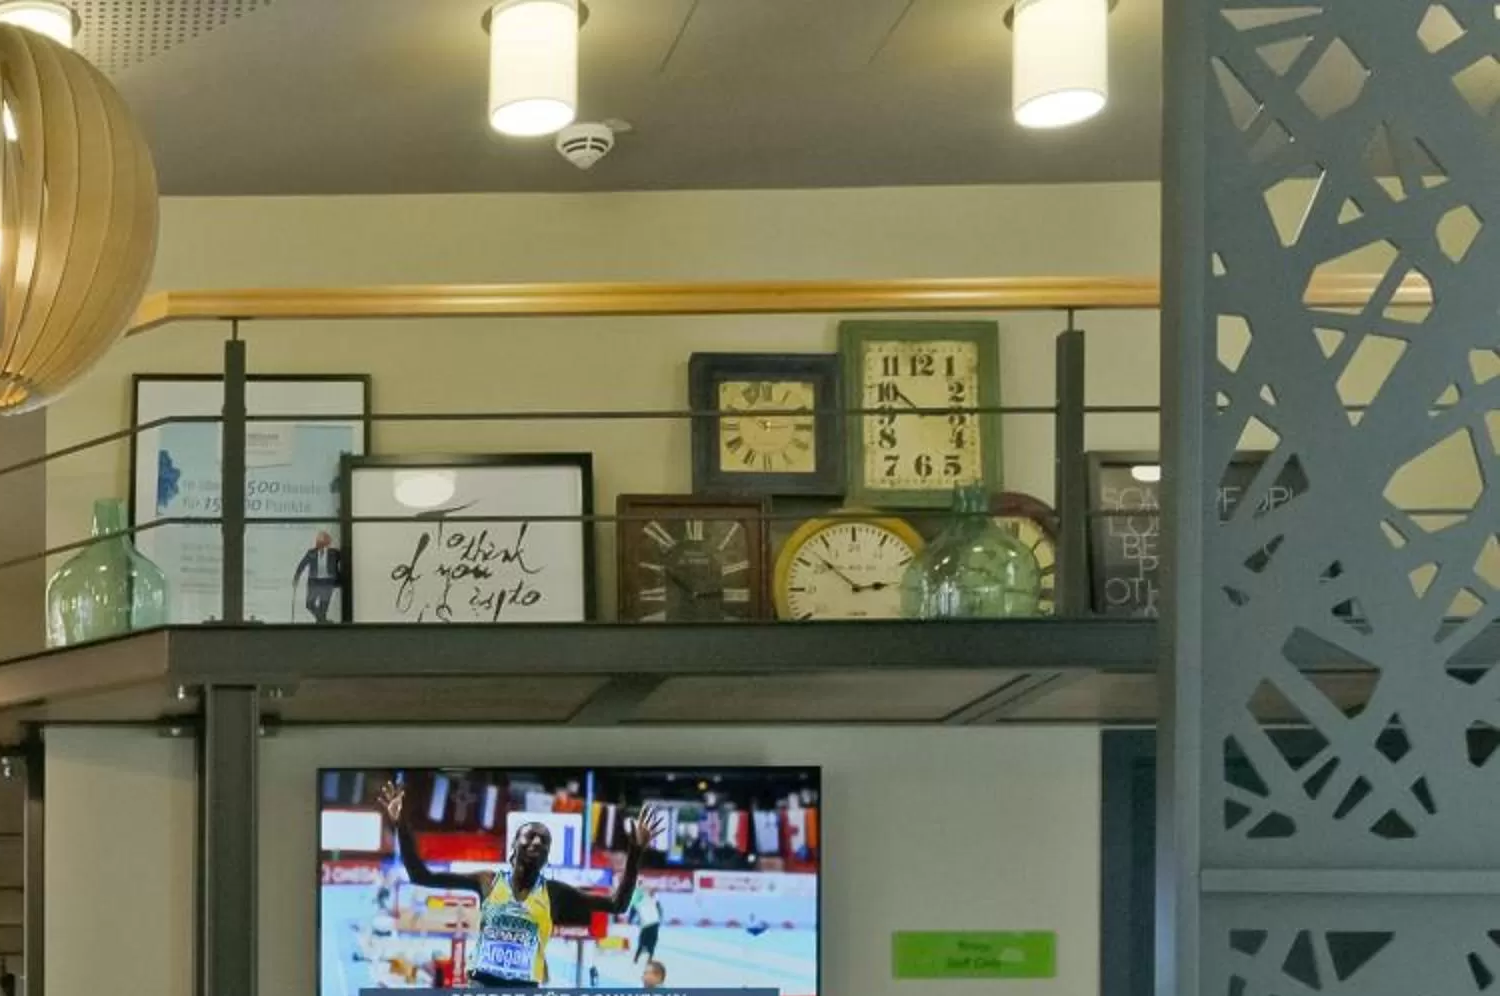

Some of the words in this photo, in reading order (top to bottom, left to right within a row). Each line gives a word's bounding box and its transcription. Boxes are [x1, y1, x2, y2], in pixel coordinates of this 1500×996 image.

[910, 355, 935, 377] 12
[945, 356, 955, 377] 1
[948, 382, 965, 402] 2
[878, 428, 897, 448] 8
[884, 455, 899, 477] 7
[914, 454, 932, 477] 6
[944, 455, 962, 476] 5
